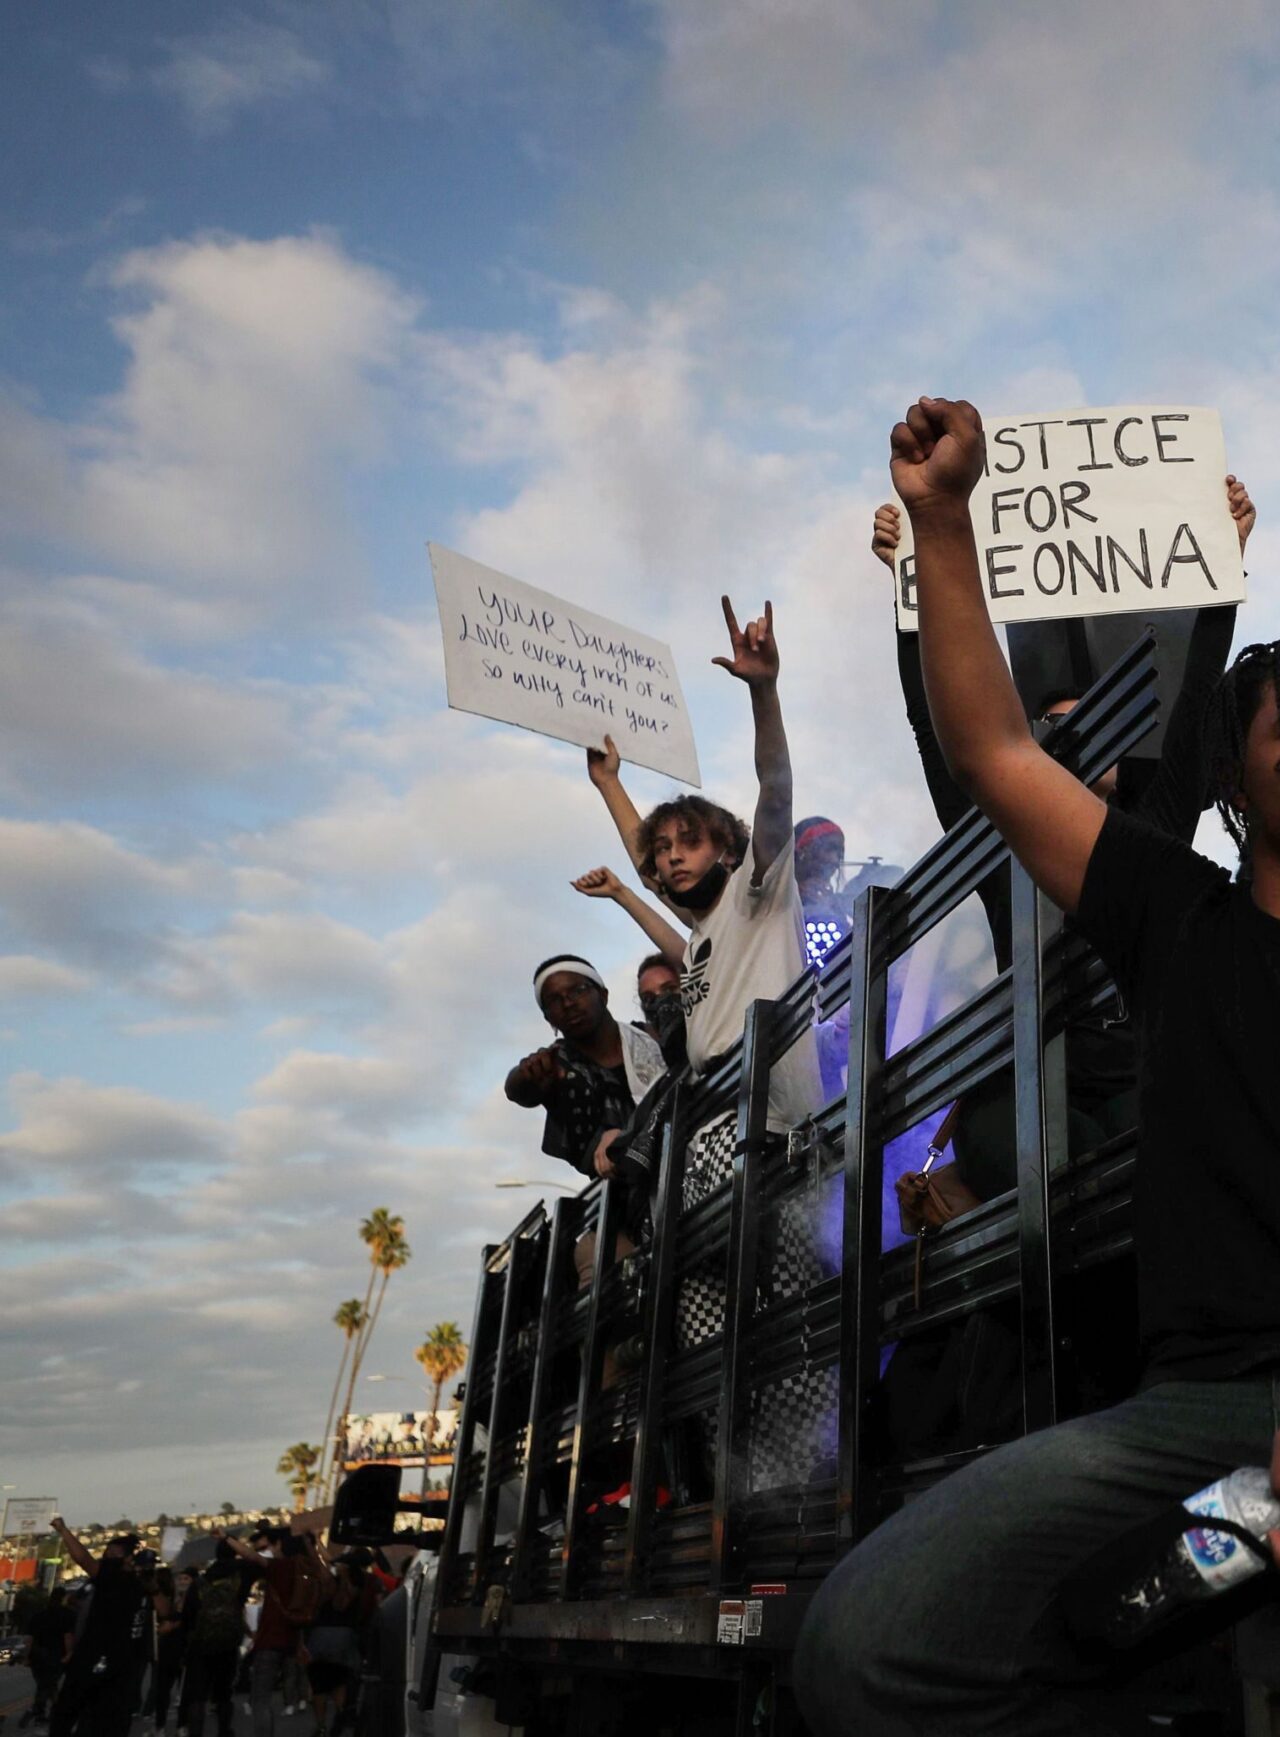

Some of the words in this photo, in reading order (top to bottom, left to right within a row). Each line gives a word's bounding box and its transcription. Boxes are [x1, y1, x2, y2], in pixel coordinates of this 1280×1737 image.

[983, 414, 1195, 477] STICE
[992, 481, 1098, 534] FOR
[900, 523, 1218, 610] EONNA
